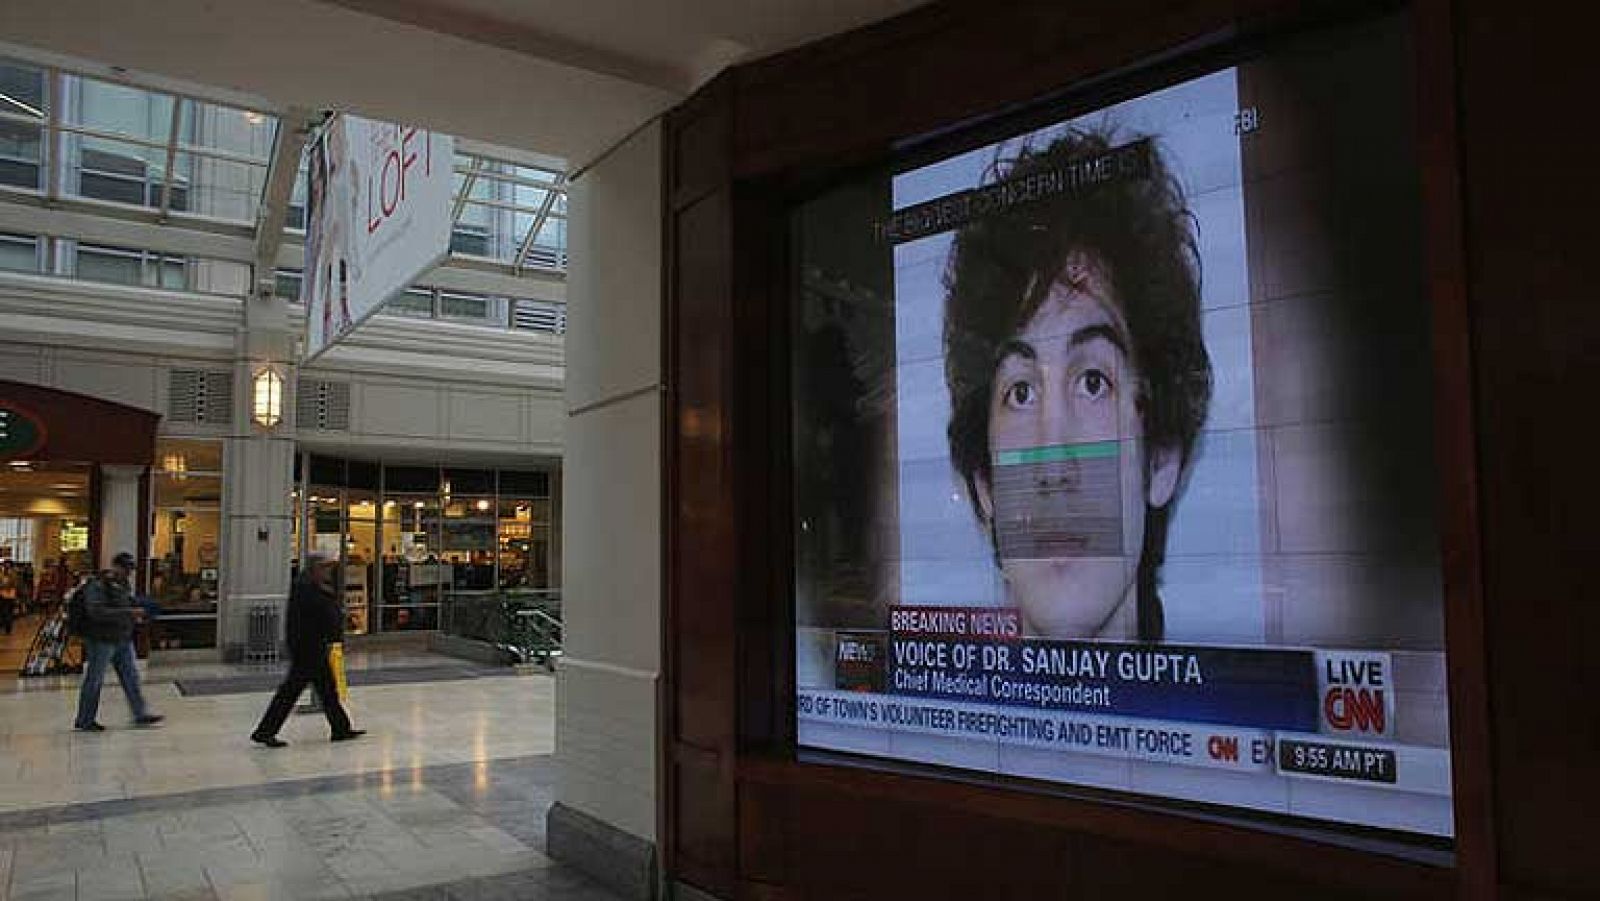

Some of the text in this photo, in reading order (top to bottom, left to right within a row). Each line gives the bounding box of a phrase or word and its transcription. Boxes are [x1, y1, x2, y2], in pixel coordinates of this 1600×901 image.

[892, 610, 1018, 636] BREAKING NEWS
[894, 641, 1203, 684] VOICE OF DR. SANJAY GUPTA
[1326, 659, 1384, 686] LIVE
[895, 669, 1111, 707] Chief Medical Correspondent
[1324, 687, 1385, 734] CNN
[816, 697, 831, 717] OF
[833, 699, 877, 721] TOWN'S
[881, 703, 955, 731] VOLUNTEER
[957, 711, 1055, 742] FIREFIGHTING
[1057, 721, 1092, 747] AND
[1097, 725, 1131, 751] EMT
[1136, 730, 1193, 757] FORCE
[1208, 735, 1239, 762] CNN
[1332, 748, 1362, 772] AM
[1365, 752, 1388, 775] PT
